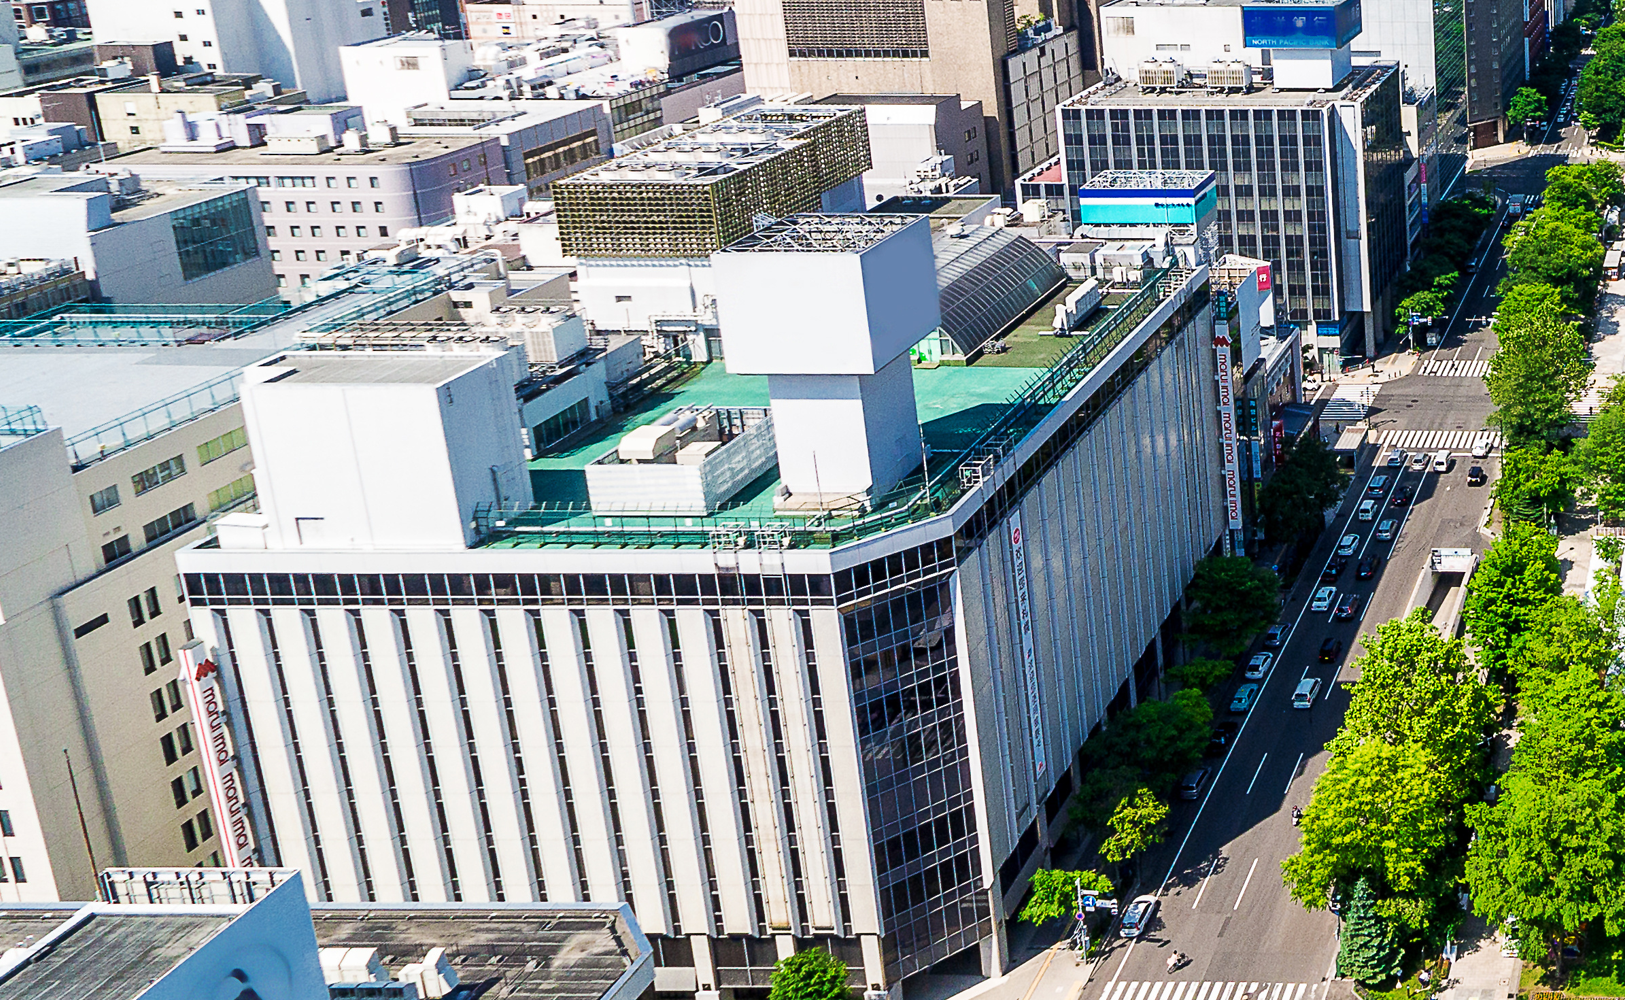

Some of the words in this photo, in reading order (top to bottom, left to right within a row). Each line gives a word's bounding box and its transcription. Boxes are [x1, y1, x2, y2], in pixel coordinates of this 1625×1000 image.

[1251, 38, 1277, 46] NORTH
[1218, 353, 1229, 383] marui
[1220, 385, 1230, 407] imai
[1222, 412, 1232, 439] marui
[1225, 443, 1234, 464] imai
[1227, 469, 1236, 498] marui
[1229, 500, 1238, 520] imai
[202, 686, 223, 733] marui
[212, 732, 230, 767] imai
[222, 771, 242, 818] marui
[231, 816, 250, 851] imai
